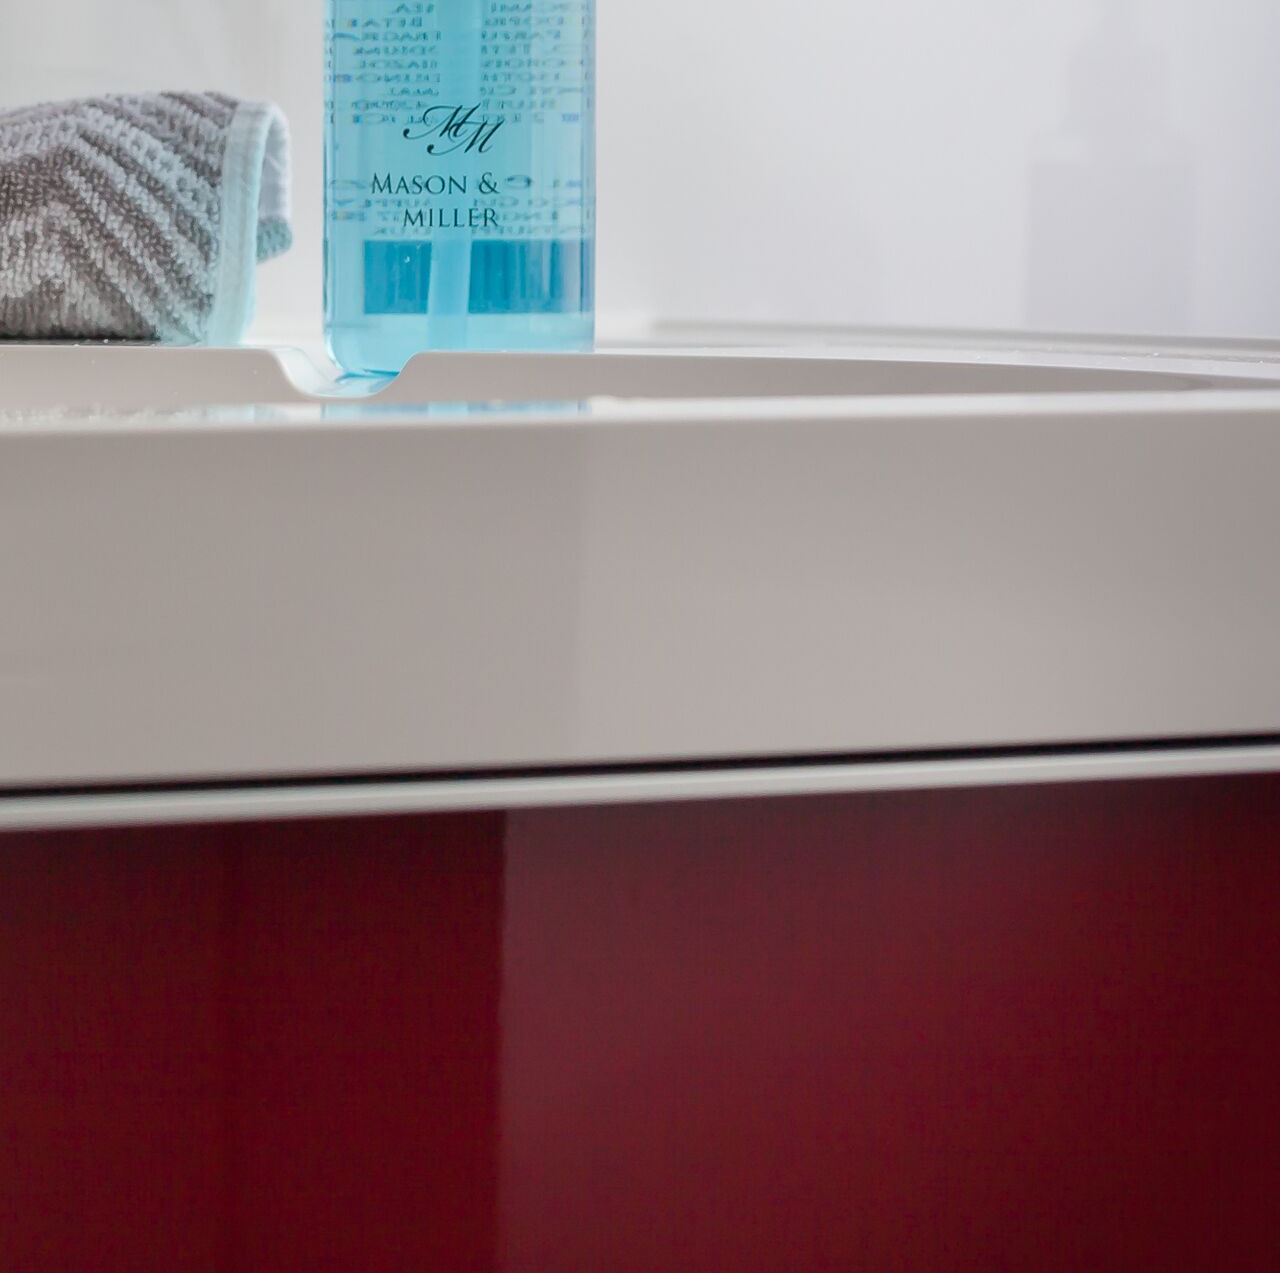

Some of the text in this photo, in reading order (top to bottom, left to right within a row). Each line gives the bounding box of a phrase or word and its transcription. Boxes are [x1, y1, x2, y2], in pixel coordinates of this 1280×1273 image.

[371, 171, 501, 195] MASON &
[403, 207, 499, 228] MILLER
